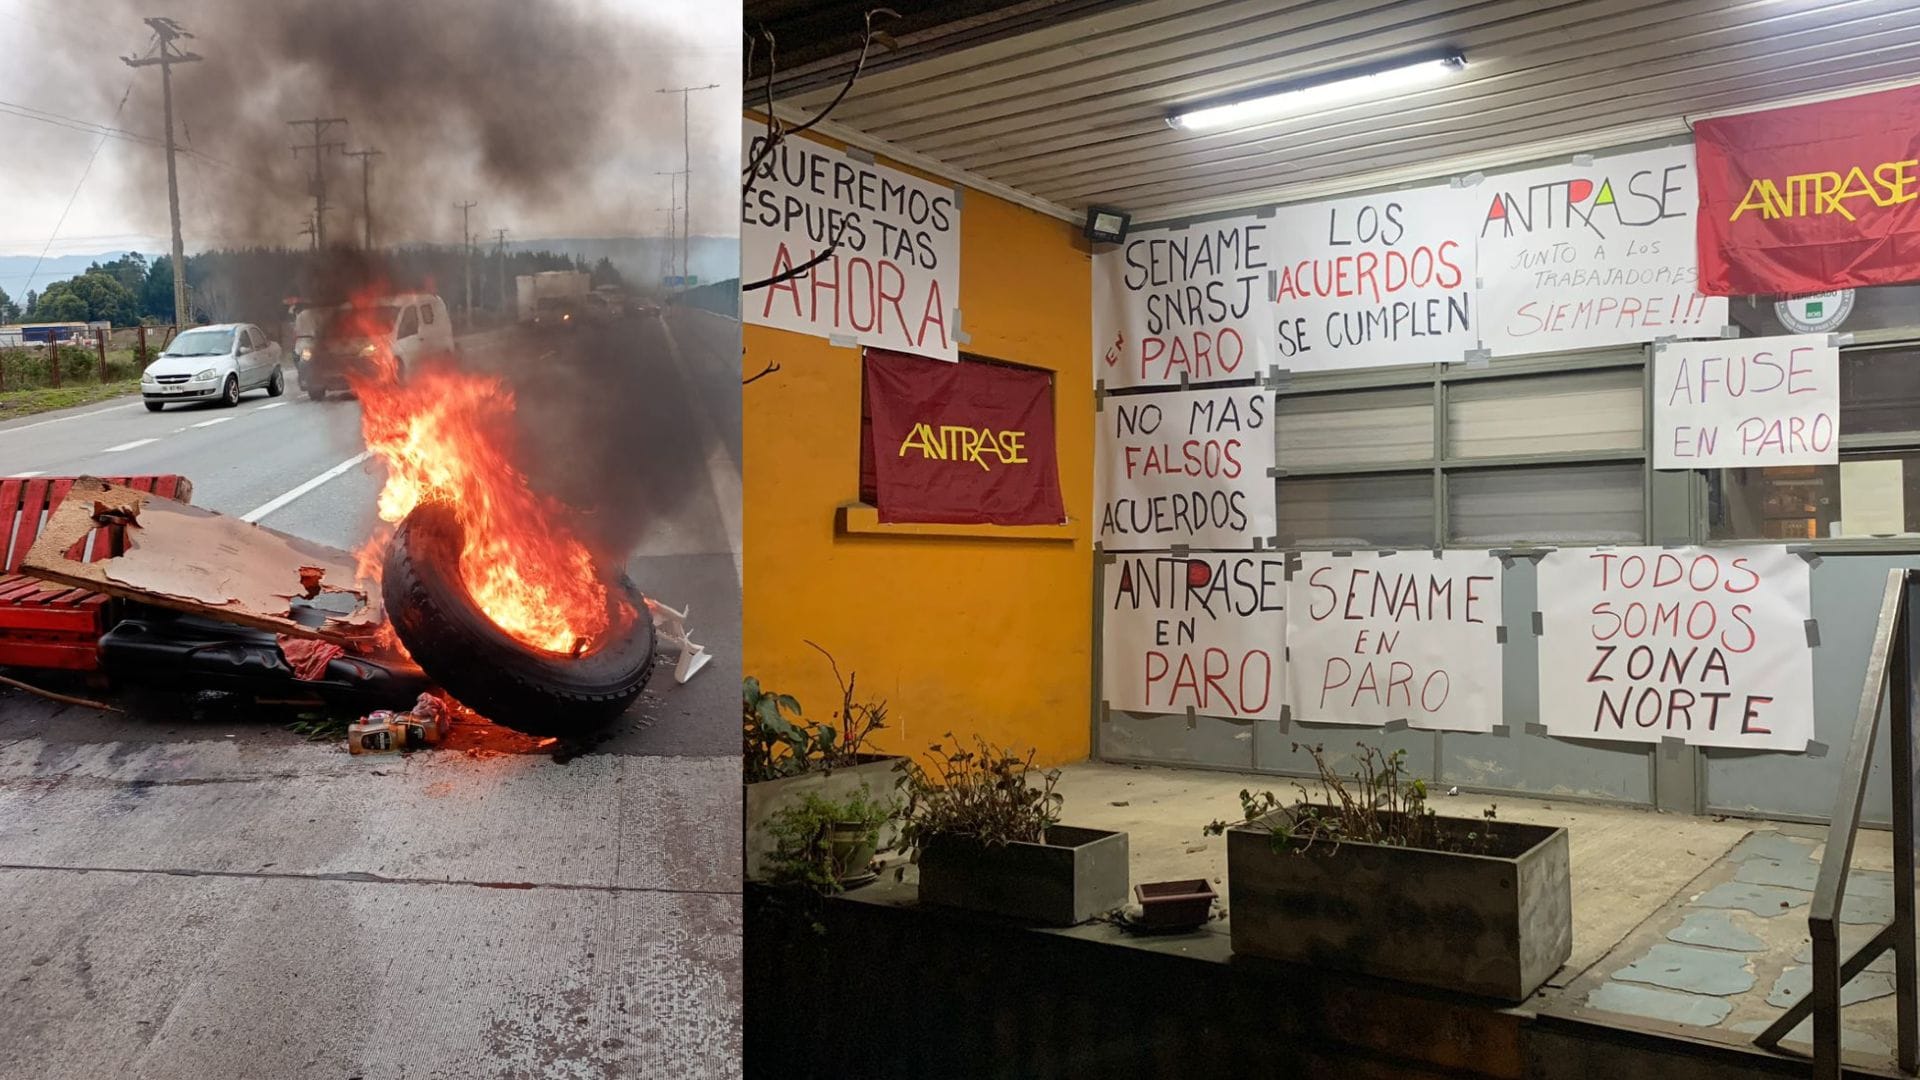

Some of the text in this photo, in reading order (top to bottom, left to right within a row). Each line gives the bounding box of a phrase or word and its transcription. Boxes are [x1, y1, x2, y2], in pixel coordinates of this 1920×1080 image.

[749, 136, 951, 232] QUEREMOS
[1481, 164, 1687, 239] ANTRASE
[1729, 159, 1919, 223] ANTRASE
[1329, 203, 1404, 246] LOS
[1124, 225, 1267, 291] SENAME
[1276, 240, 1463, 303] ACUERDOS
[1510, 242, 1576, 269] JUNTO
[1594, 245, 1605, 260] A
[1535, 266, 1699, 289] TRABAJADORES
[763, 242, 948, 349] AHORA
[1147, 275, 1259, 335] SNRSJ
[1507, 293, 1708, 336] SIEMPRE!!!
[1279, 292, 1470, 356] SE CUMPLEN
[1105, 327, 1244, 380] EN PARO
[1669, 348, 1816, 406] AFUSE
[1117, 395, 1264, 438] NO MAS
[1674, 413, 1833, 458] EN PARO
[899, 422, 1028, 471] ANTRASE
[1125, 439, 1242, 479] FALSOS
[1101, 490, 1247, 536] ACUERDOS
[1115, 558, 1283, 620] ANTRASE
[1309, 567, 1494, 623] SENAME
[1590, 554, 1760, 593] TODOS
[1156, 617, 1195, 646] EN
[1354, 629, 1399, 654] EN
[1591, 600, 1756, 653] SOMOS
[1145, 647, 1272, 715] PARO
[1320, 657, 1450, 712] PARO
[1586, 645, 1729, 685] ZONA
[1594, 686, 1774, 735] NORTE
